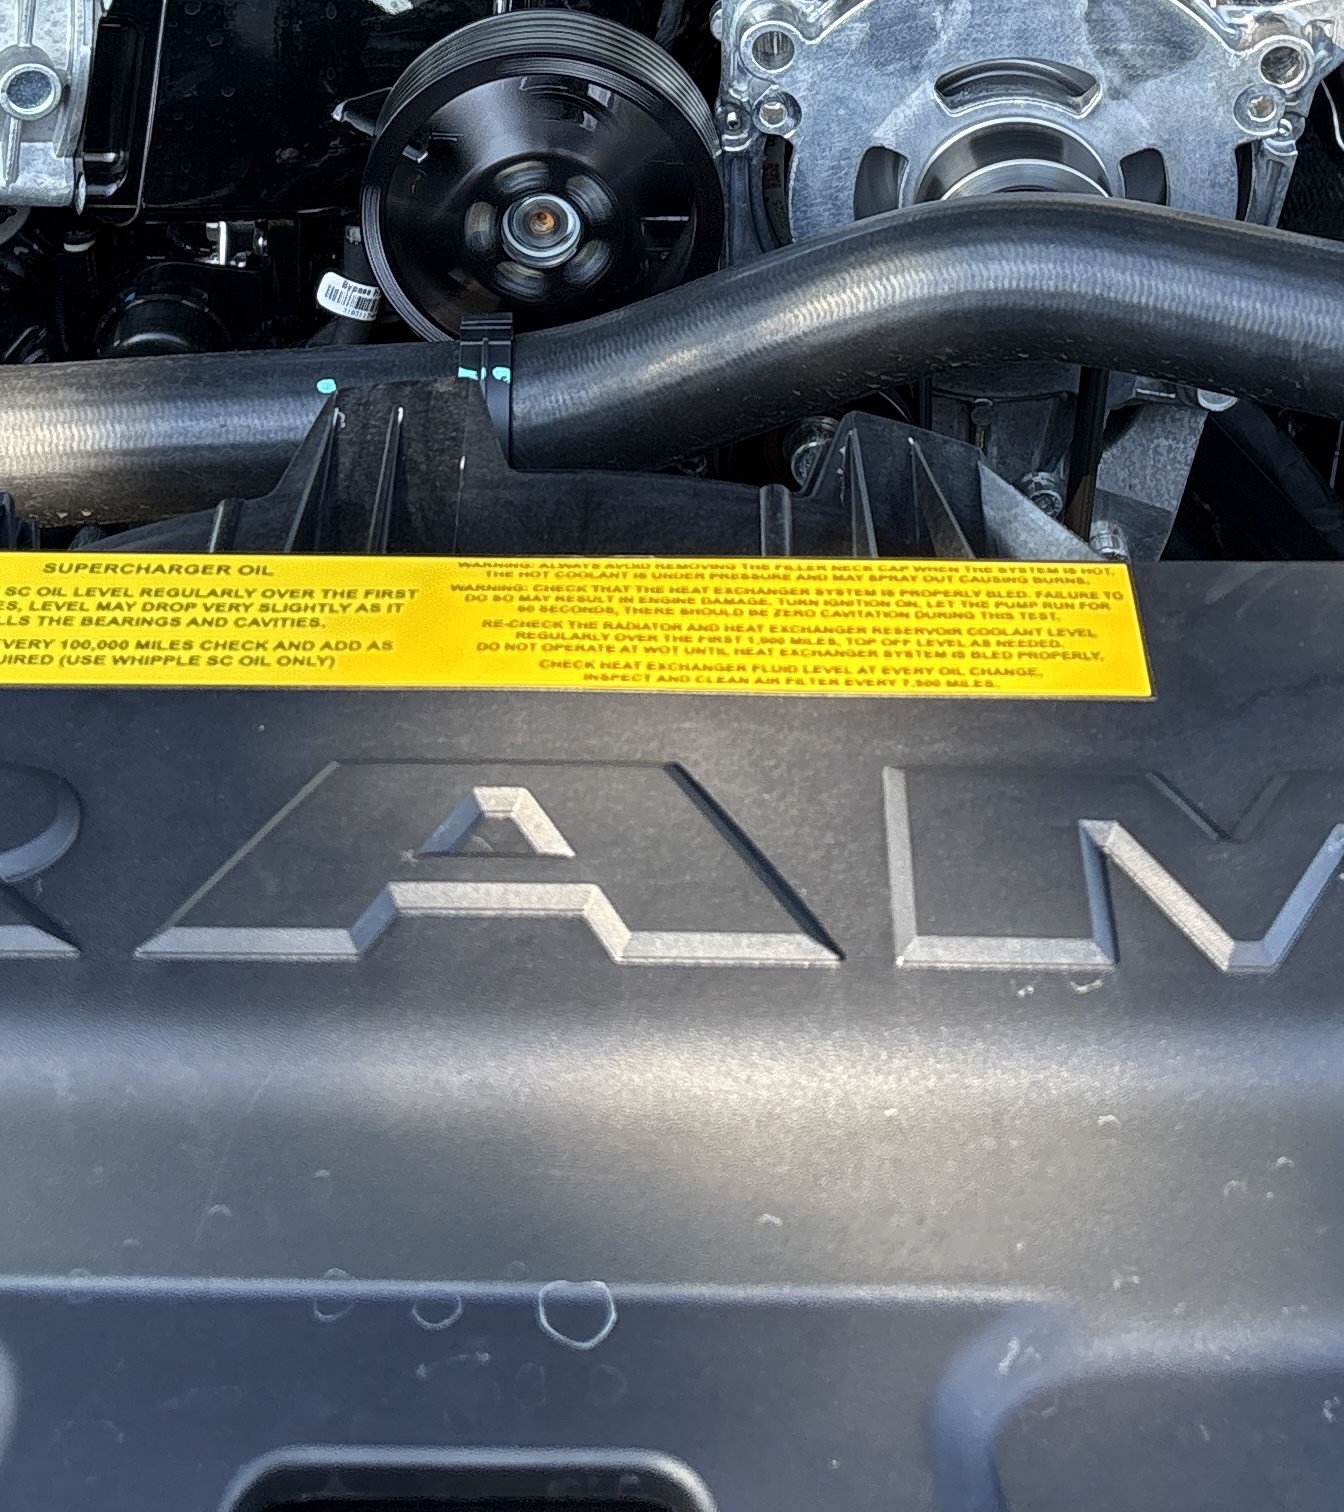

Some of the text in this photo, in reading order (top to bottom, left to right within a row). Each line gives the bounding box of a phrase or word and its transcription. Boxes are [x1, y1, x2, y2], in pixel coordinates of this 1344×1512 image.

[43, 562, 273, 576] SUPERCHARGER OIL
[5, 586, 31, 597] SC
[37, 587, 67, 597] OIL
[73, 587, 133, 598] LEVEL
[139, 587, 257, 598] REGULARLY
[261, 588, 315, 599] OVER
[321, 589, 358, 599] THE
[363, 589, 418, 600] FIRST
[28, 601, 89, 611] LEVEL
[96, 601, 136, 612] MAY
[141, 601, 197, 612] DROP
[202, 602, 254, 613] VERY
[258, 602, 351, 614] SLIGHTLY
[355, 603, 381, 614] AS
[387, 603, 403, 614] IT
[38, 616, 74, 626] THE
[80, 616, 181, 627] BEARINGS
[186, 617, 228, 627] AND
[61, 639, 129, 651] 100,000
[135, 640, 194, 650] MILES
[199, 640, 268, 651] CHECK
[273, 640, 315, 651] AND
[320, 641, 361, 651] ADD
[367, 641, 393, 652] AS
[58, 655, 106, 666] (USE
[111, 655, 200, 666] WHIPPLE
[207, 656, 233, 666] SC
[238, 656, 270, 666] OIL
[276, 656, 335, 668] ONLY)
